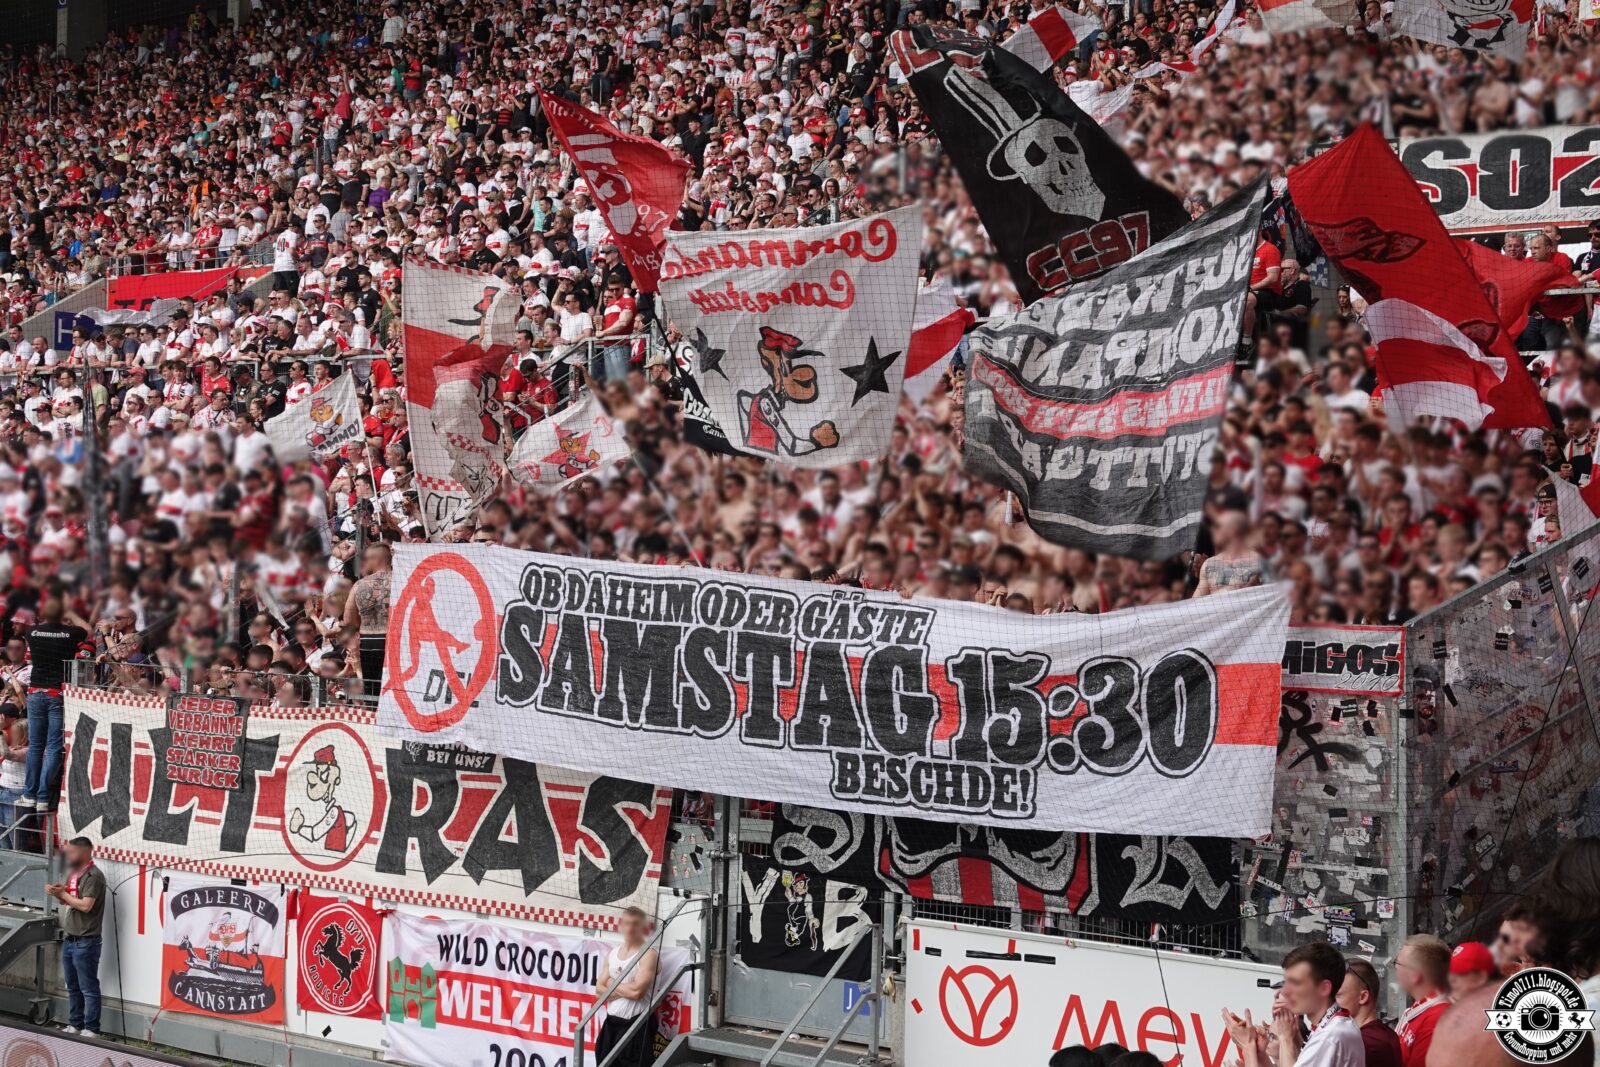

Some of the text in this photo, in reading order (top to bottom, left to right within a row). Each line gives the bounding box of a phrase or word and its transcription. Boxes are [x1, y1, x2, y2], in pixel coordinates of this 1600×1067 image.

[1026, 210, 1150, 291] CC97
[523, 565, 931, 645] OB DAHEIM ODER GÄSTE
[498, 602, 1217, 778] SAMSTAG 15:30
[177, 696, 236, 716] JEDER
[168, 709, 244, 737] VERBANNTE
[173, 731, 236, 752] KEHRT
[427, 750, 491, 768] BEI UNS!
[167, 764, 239, 789] ZURÜCK
[833, 750, 1036, 816] BESCHDE!
[180, 890, 267, 917] GALEERE
[437, 933, 599, 987] WILD CROCODIL
[174, 981, 266, 1011] CANNSTATT
